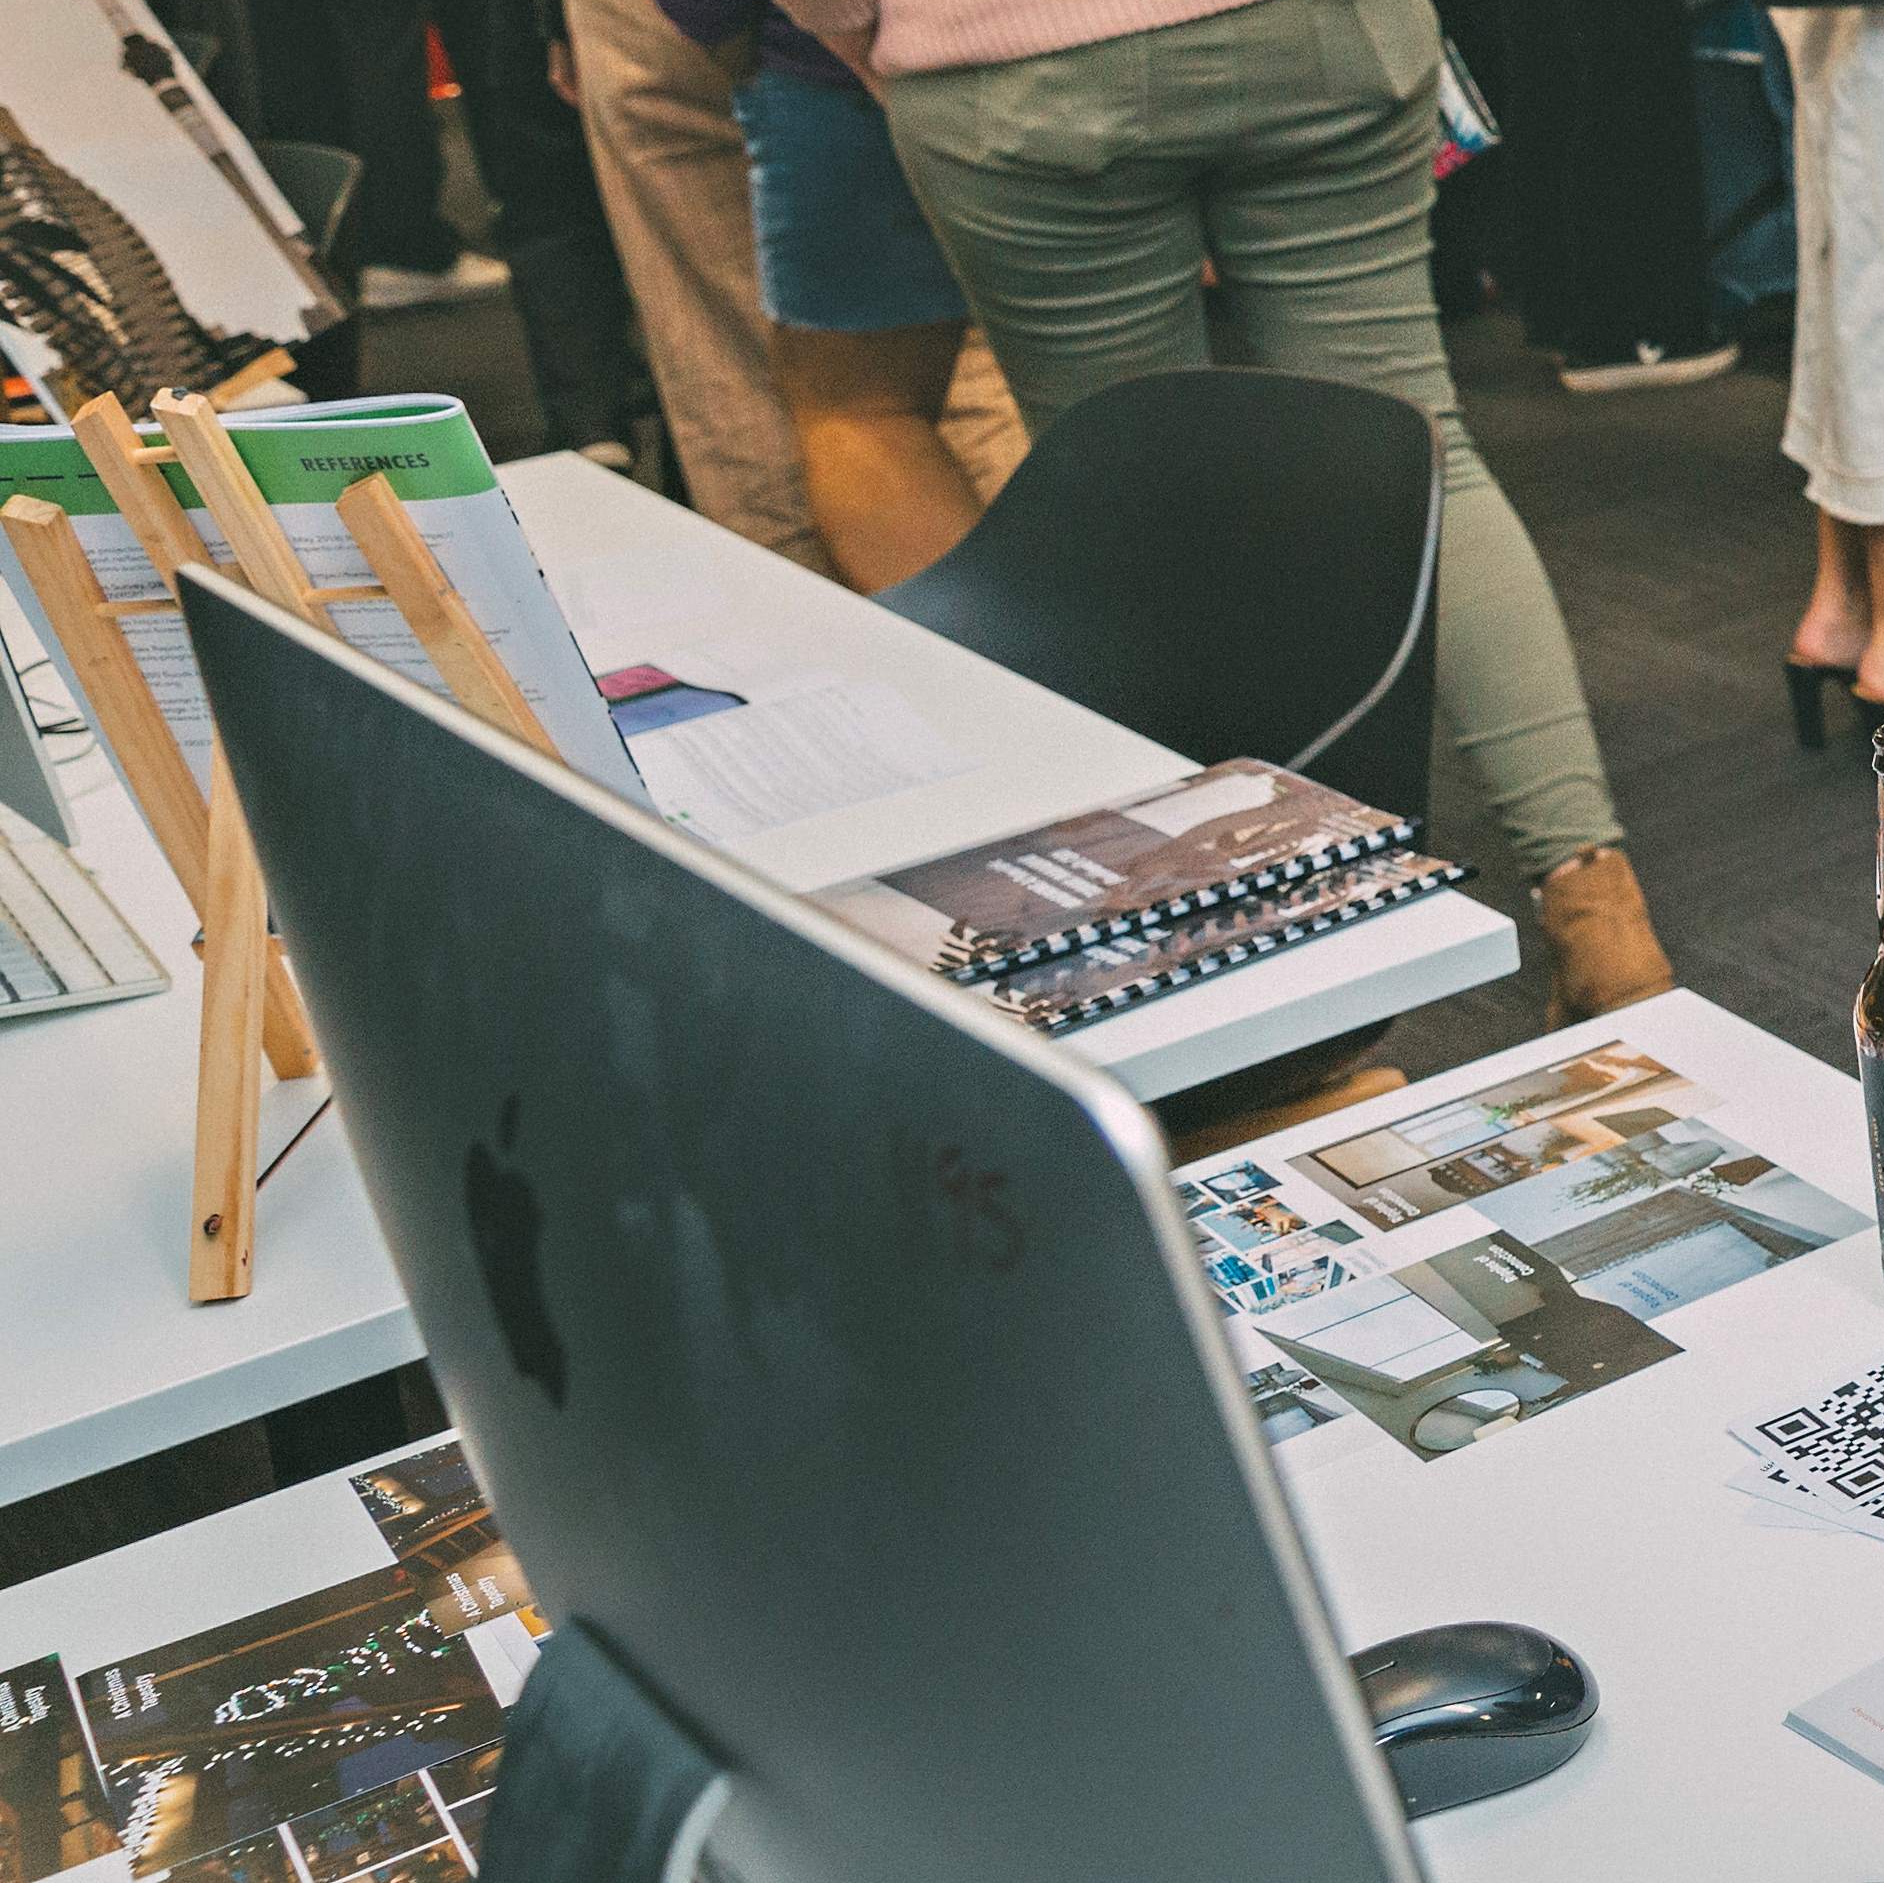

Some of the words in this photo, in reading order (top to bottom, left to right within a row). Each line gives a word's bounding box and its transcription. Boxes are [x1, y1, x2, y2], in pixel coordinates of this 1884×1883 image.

[301, 451, 431, 474] REFERENCES
[446, 1572, 478, 1613] Christmas
[477, 1575, 506, 1610] Tapestry
[466, 1607, 484, 1618] A
[24, 1685, 52, 1725] Tapestry
[105, 1667, 131, 1714] Christmas
[135, 1673, 162, 1713] Tapestry
[114, 1708, 134, 1720] A
